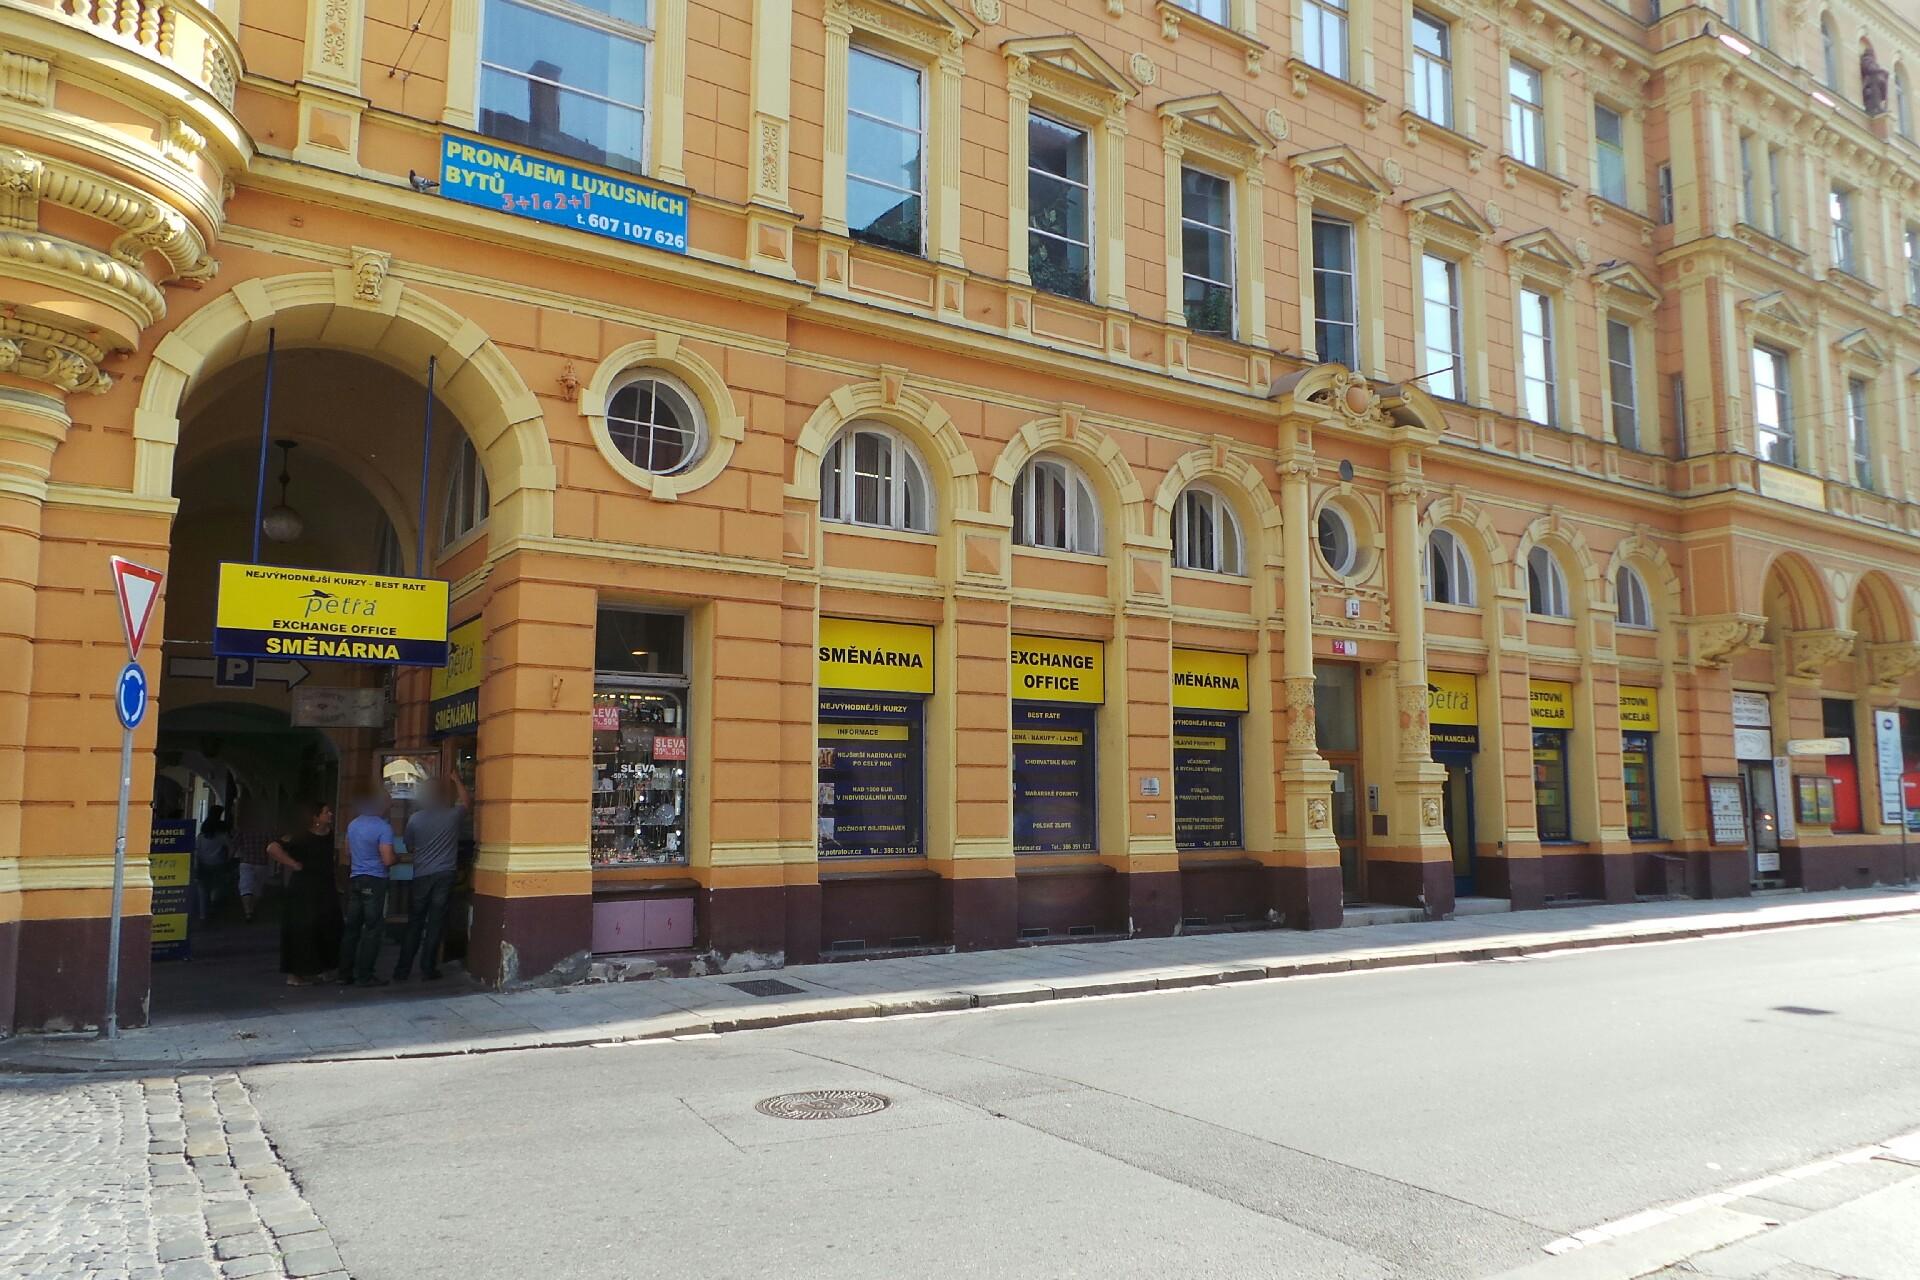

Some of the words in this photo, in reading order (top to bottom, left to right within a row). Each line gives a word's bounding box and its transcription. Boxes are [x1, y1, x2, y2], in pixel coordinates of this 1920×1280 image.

[445, 165, 505, 195] BYTŮ
[447, 140, 566, 186] PRONÁJEM
[571, 173, 684, 217] LUXUSNÍCH
[502, 193, 540, 211] 3+1
[555, 192, 591, 210] 2+1
[576, 213, 586, 225] t.
[588, 213, 620, 233] 607
[623, 221, 653, 241] 107
[654, 230, 685, 249] 626
[334, 577, 368, 588] KURZY
[375, 580, 399, 590] BEST
[402, 583, 426, 592] RATE
[272, 620, 347, 634] EXCHANGE
[350, 625, 398, 636] OFFICE
[265, 636, 401, 660] SMĚNÁRNA
[819, 645, 924, 668] SMĚNÁRNA
[1010, 650, 1094, 670] EXCHANGE
[226, 659, 249, 681] P
[1024, 674, 1080, 692] OFFICE
[1172, 671, 1240, 690] MĚNÁRNA
[1530, 690, 1562, 702] ESTOVNÍ
[1620, 696, 1648, 707] ESTOVNÍ
[434, 701, 477, 731] SMĚNÁRNA
[592, 708, 618, 718] LEVA
[1044, 712, 1061, 720] RATE
[837, 728, 879, 736] INFORMACE
[655, 738, 686, 749] SLEVA
[620, 764, 656, 773] SLEVA
